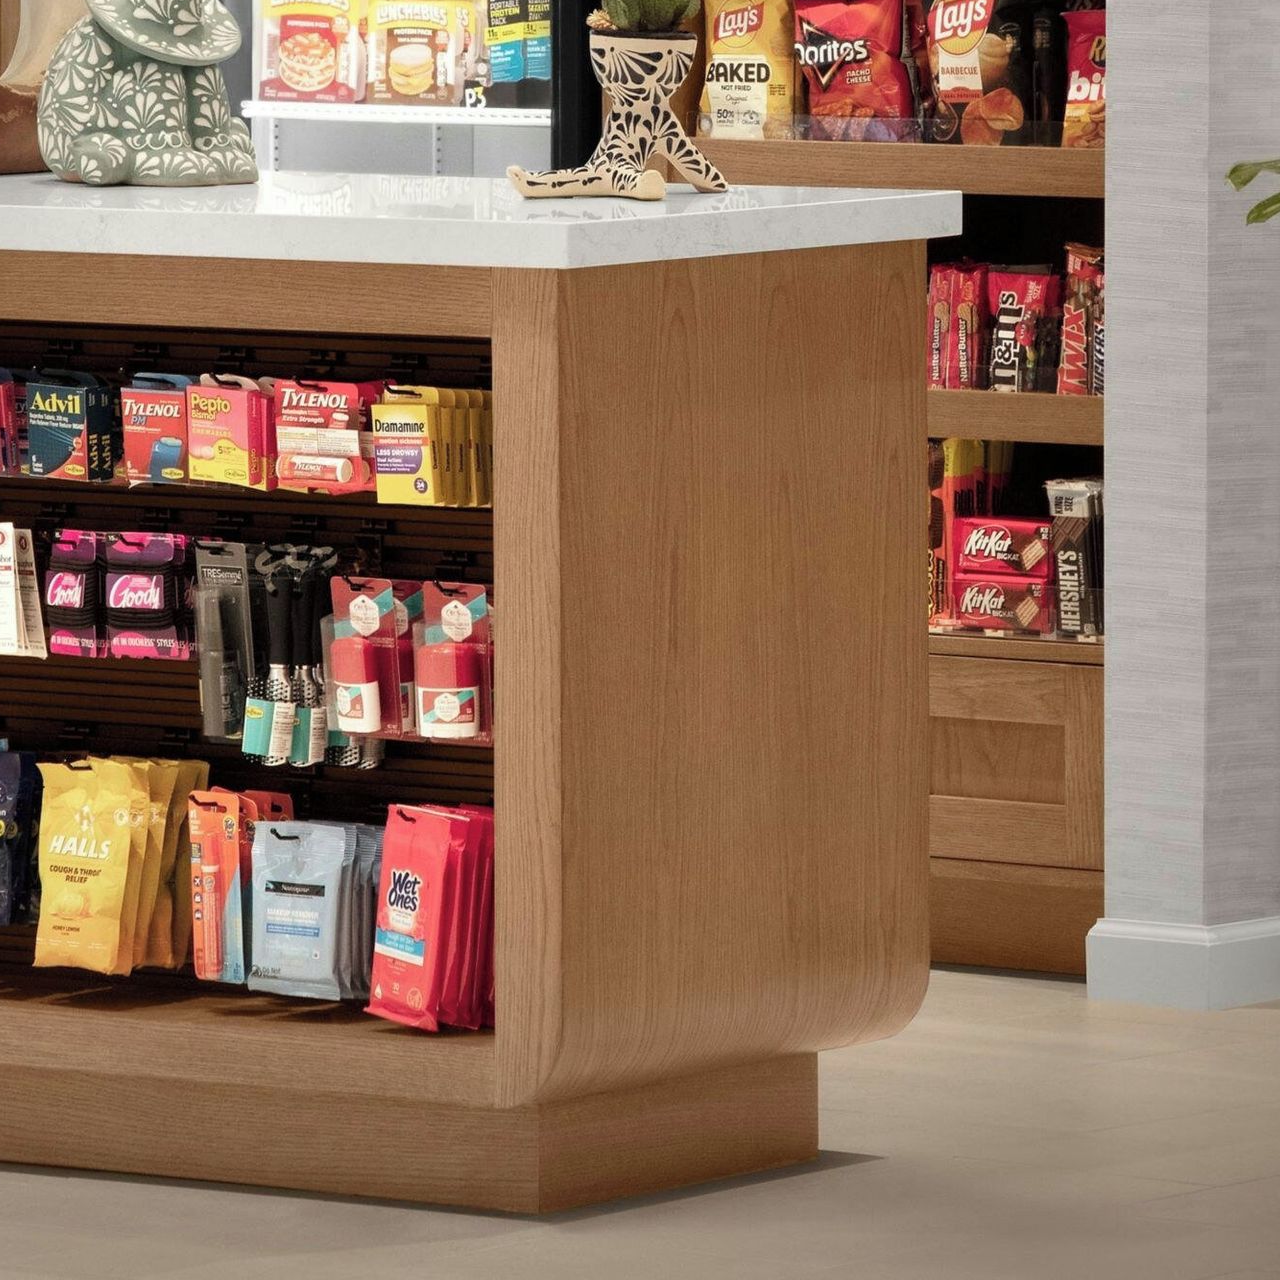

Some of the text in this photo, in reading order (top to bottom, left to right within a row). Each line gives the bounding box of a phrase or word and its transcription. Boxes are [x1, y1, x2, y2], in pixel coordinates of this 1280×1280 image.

[375, 4, 448, 26] LUNCHABLES
[489, 0, 520, 10] PORTABLE
[490, 6, 520, 18] PROTEIN
[491, 18, 507, 26] PACK
[718, 6, 760, 38] Lay's
[706, 63, 770, 83] BAKED
[846, 76, 871, 84] CHEESE
[940, 65, 979, 76] BARBECUE
[465, 86, 486, 108] P3
[734, 84, 751, 92] FRIED
[716, 109, 735, 119] 50%
[932, 318, 940, 380] Nutter Butter
[959, 318, 968, 382] Nutter Butter
[30, 391, 81, 414] Advil
[123, 399, 181, 418] TYLENOL
[190, 393, 232, 415] Pepto
[281, 388, 349, 409] TYLENOL
[131, 415, 146, 426] PM
[191, 409, 216, 421] Bismol
[282, 415, 325, 424] Extra Strength
[374, 419, 425, 434] Dramamine
[399, 437, 423, 445] sickness
[89, 434, 99, 470] Advil
[101, 434, 112, 470] Advil
[392, 449, 419, 457] DROWSY
[294, 461, 323, 473] TYLENOL
[1054, 495, 1074, 516] KING SIZE
[46, 572, 82, 608] Goody
[109, 574, 161, 609] Goody
[1058, 550, 1081, 631] HERSHEY'S
[48, 835, 112, 860] HALLS
[49, 864, 73, 874] COUGH
[65, 875, 88, 884] RELIEF
[392, 871, 421, 896] Wet
[388, 888, 419, 912] Ones
